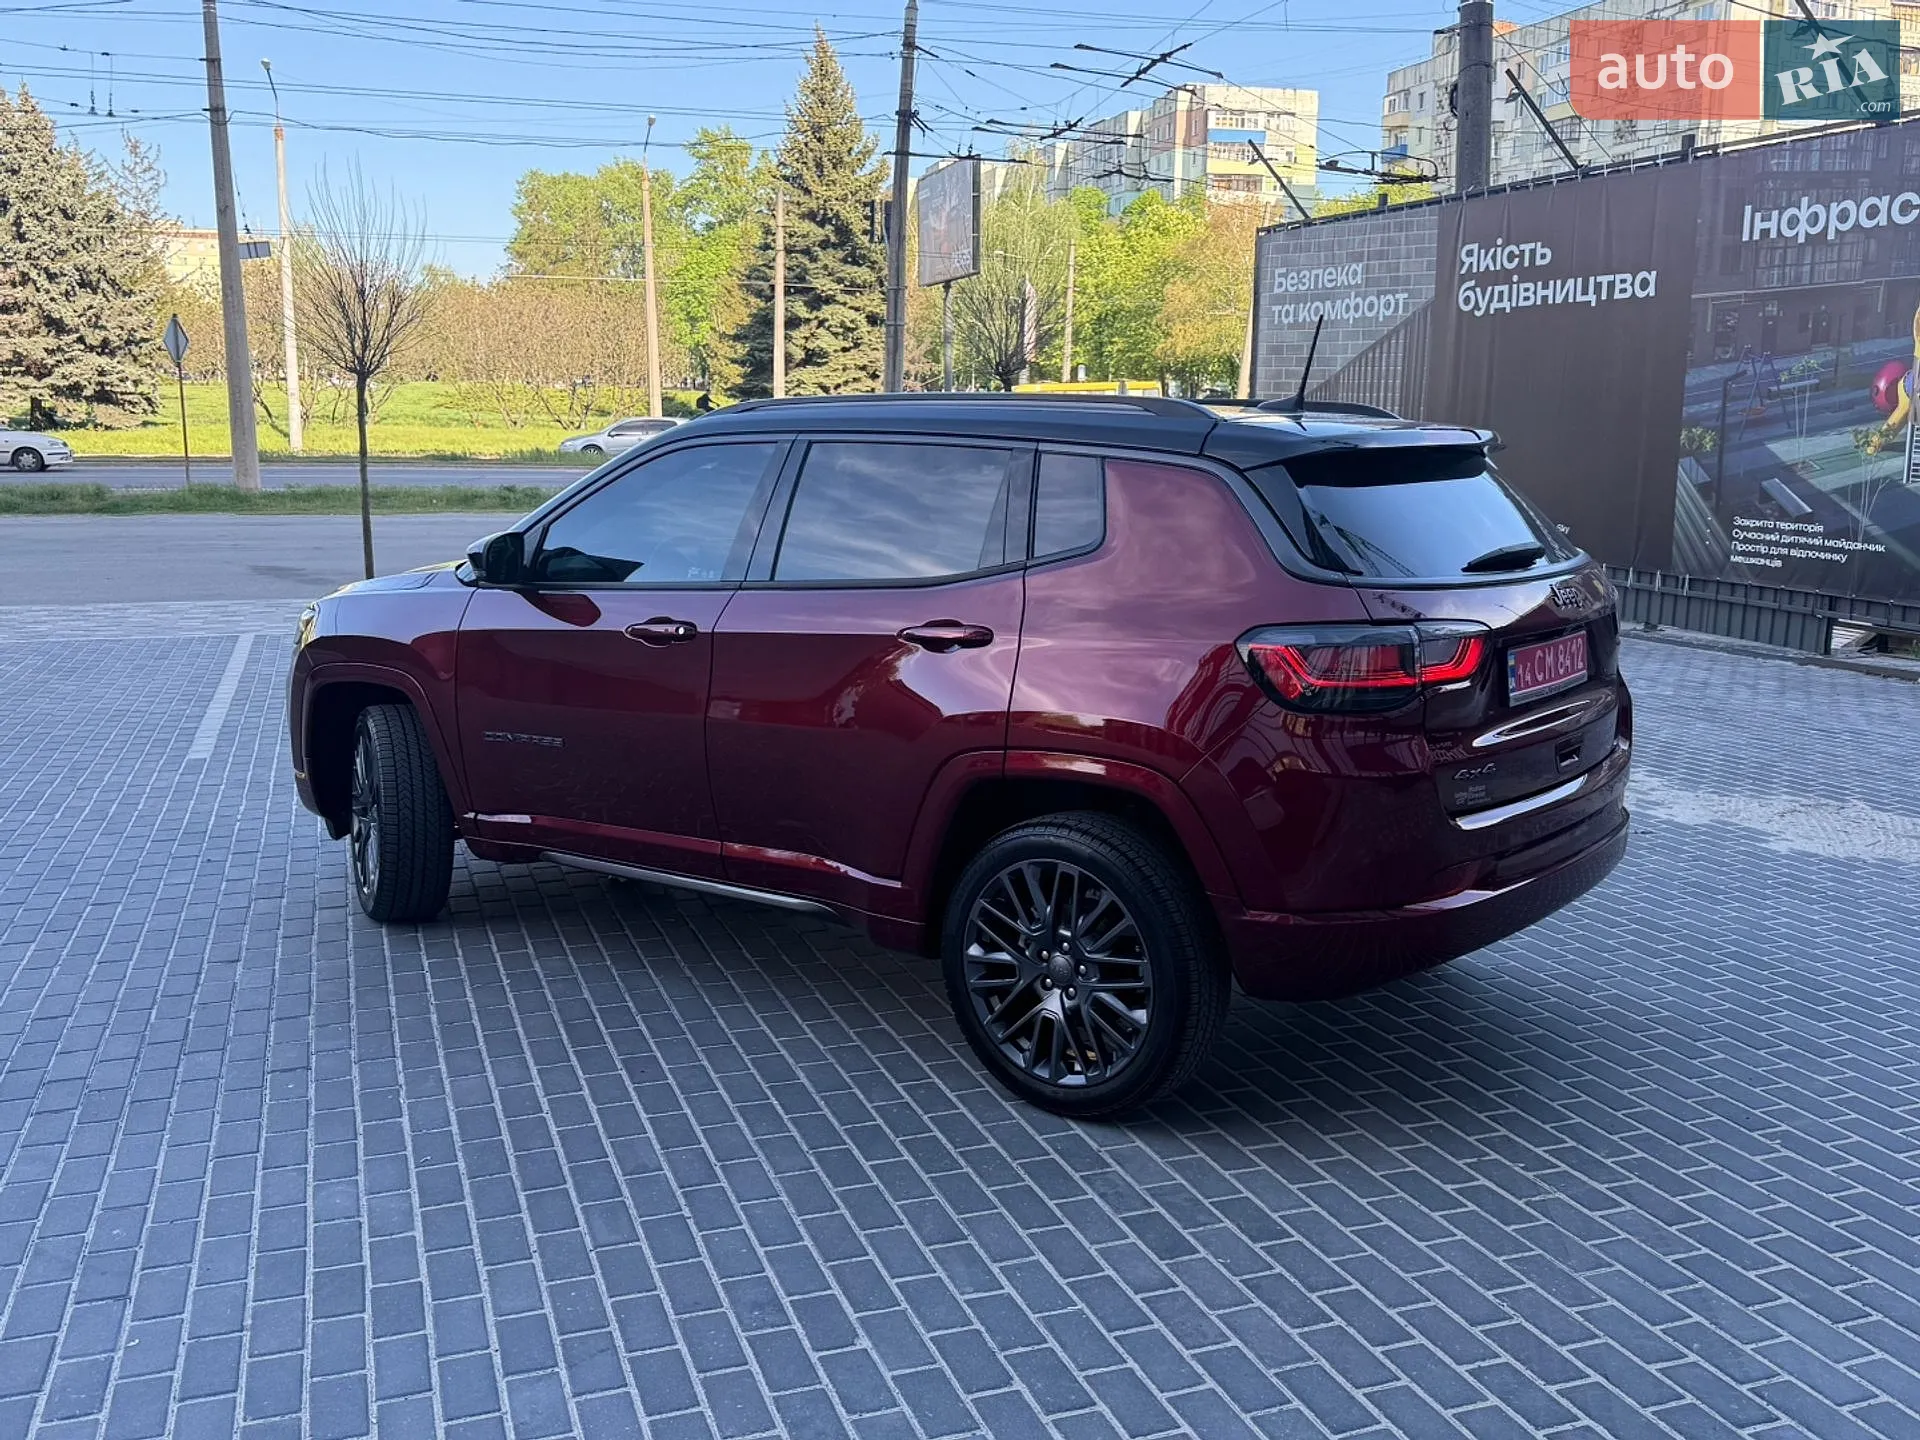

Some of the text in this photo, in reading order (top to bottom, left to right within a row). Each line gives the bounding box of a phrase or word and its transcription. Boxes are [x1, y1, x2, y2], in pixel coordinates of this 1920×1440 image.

[1741, 191, 1920, 244] Інфрас
[1459, 237, 1552, 275] Якість
[1273, 262, 1363, 294] Безпека
[1272, 290, 1409, 325] та комфорт
[1457, 269, 1658, 317] будівництва
[1732, 516, 1824, 533] Закрита територія
[1730, 541, 1848, 563] Простір для відпочинку
[1731, 528, 1886, 553] Сучасний дитячий майданчик
[1730, 554, 1783, 568] мешканців
[1517, 662, 1532, 688] 14
